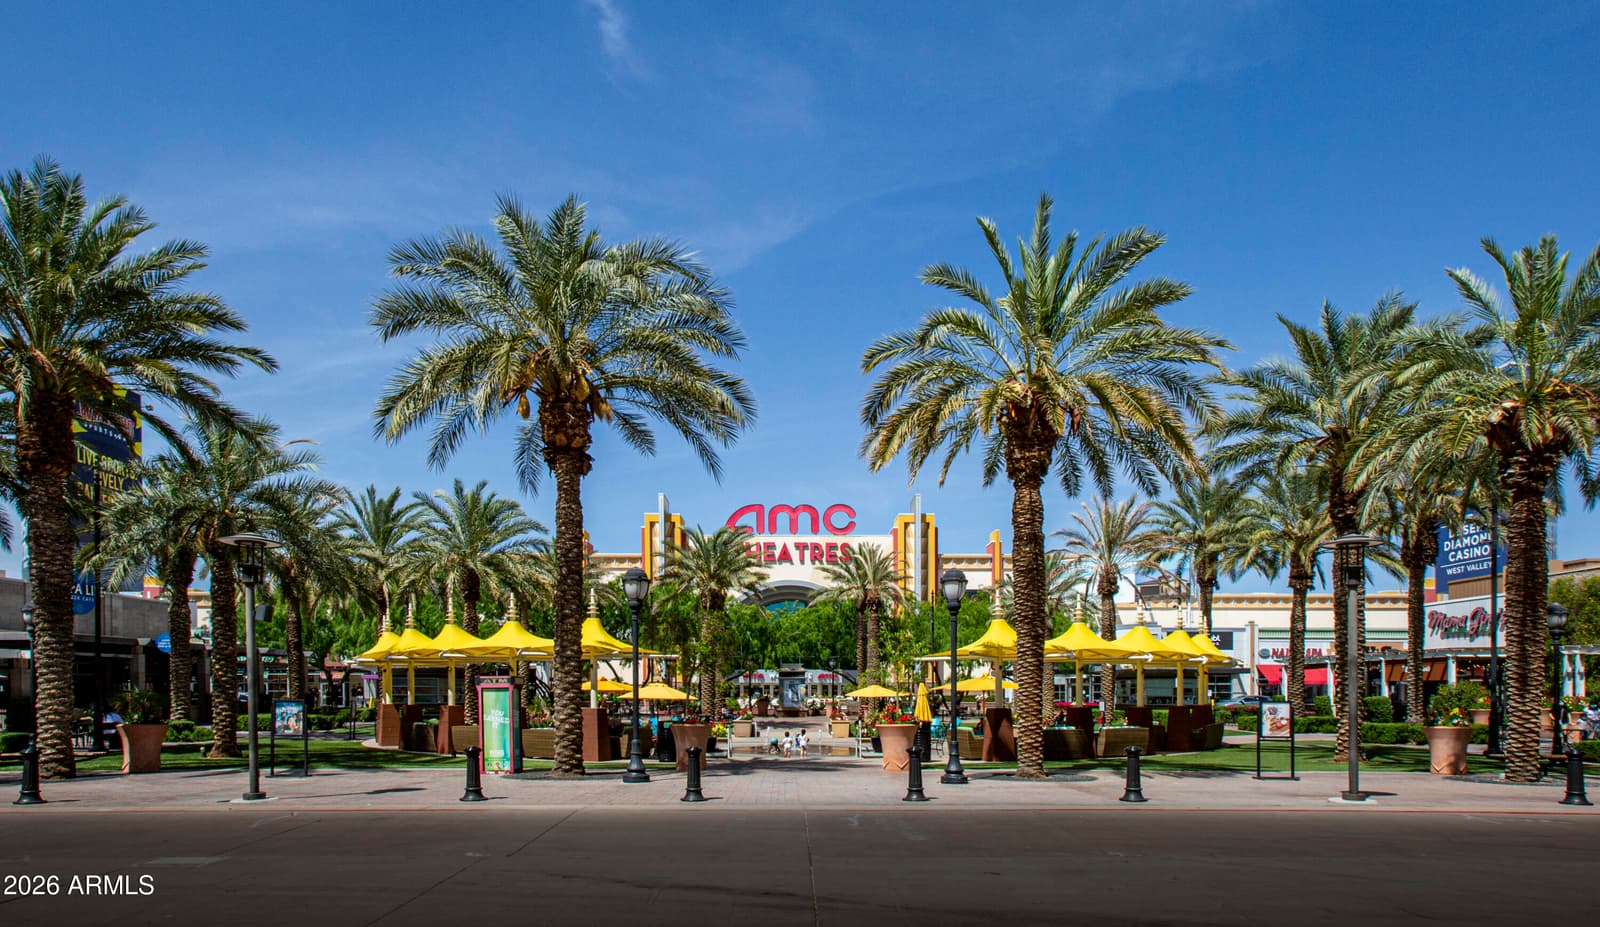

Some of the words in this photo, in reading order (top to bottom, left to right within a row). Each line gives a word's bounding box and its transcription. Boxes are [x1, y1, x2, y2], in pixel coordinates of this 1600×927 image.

[98, 471, 124, 493] IVELY
[736, 541, 853, 563] HEATRES
[1449, 545, 1491, 562] CASINO
[1446, 565, 1465, 576] WEST
[1466, 561, 1492, 572] VALLEY
[1271, 647, 1290, 658] NAI
